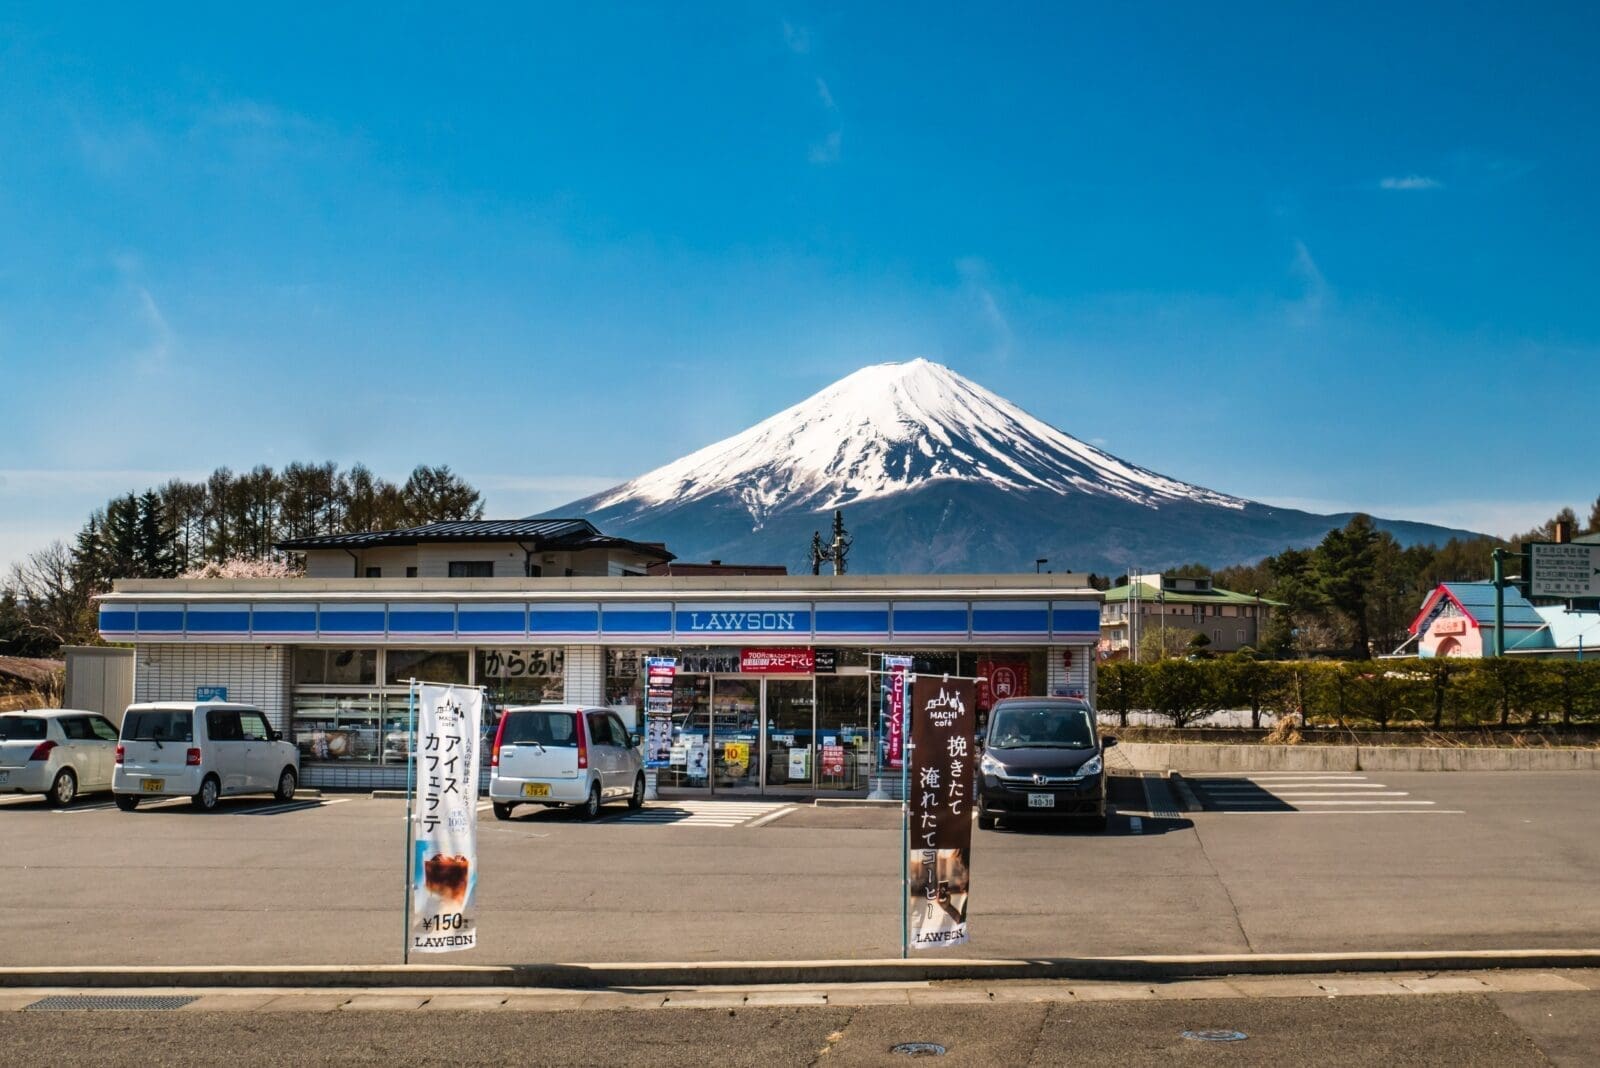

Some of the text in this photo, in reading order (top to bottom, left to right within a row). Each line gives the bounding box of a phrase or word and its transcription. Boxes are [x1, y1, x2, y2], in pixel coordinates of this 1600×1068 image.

[691, 613, 795, 630] LAWSON
[770, 658, 813, 667] スピードくじ
[892, 670, 903, 734] スピードくじ
[930, 711, 958, 720] MACHI
[725, 748, 738, 760] 10
[443, 734, 462, 795] アイス
[423, 732, 442, 834] カフェラテ
[947, 735, 968, 816] 挽きたて
[920, 766, 941, 920] 淹れたてコーヒー
[422, 912, 463, 931] ¥150
[415, 934, 474, 948] LAWSON
